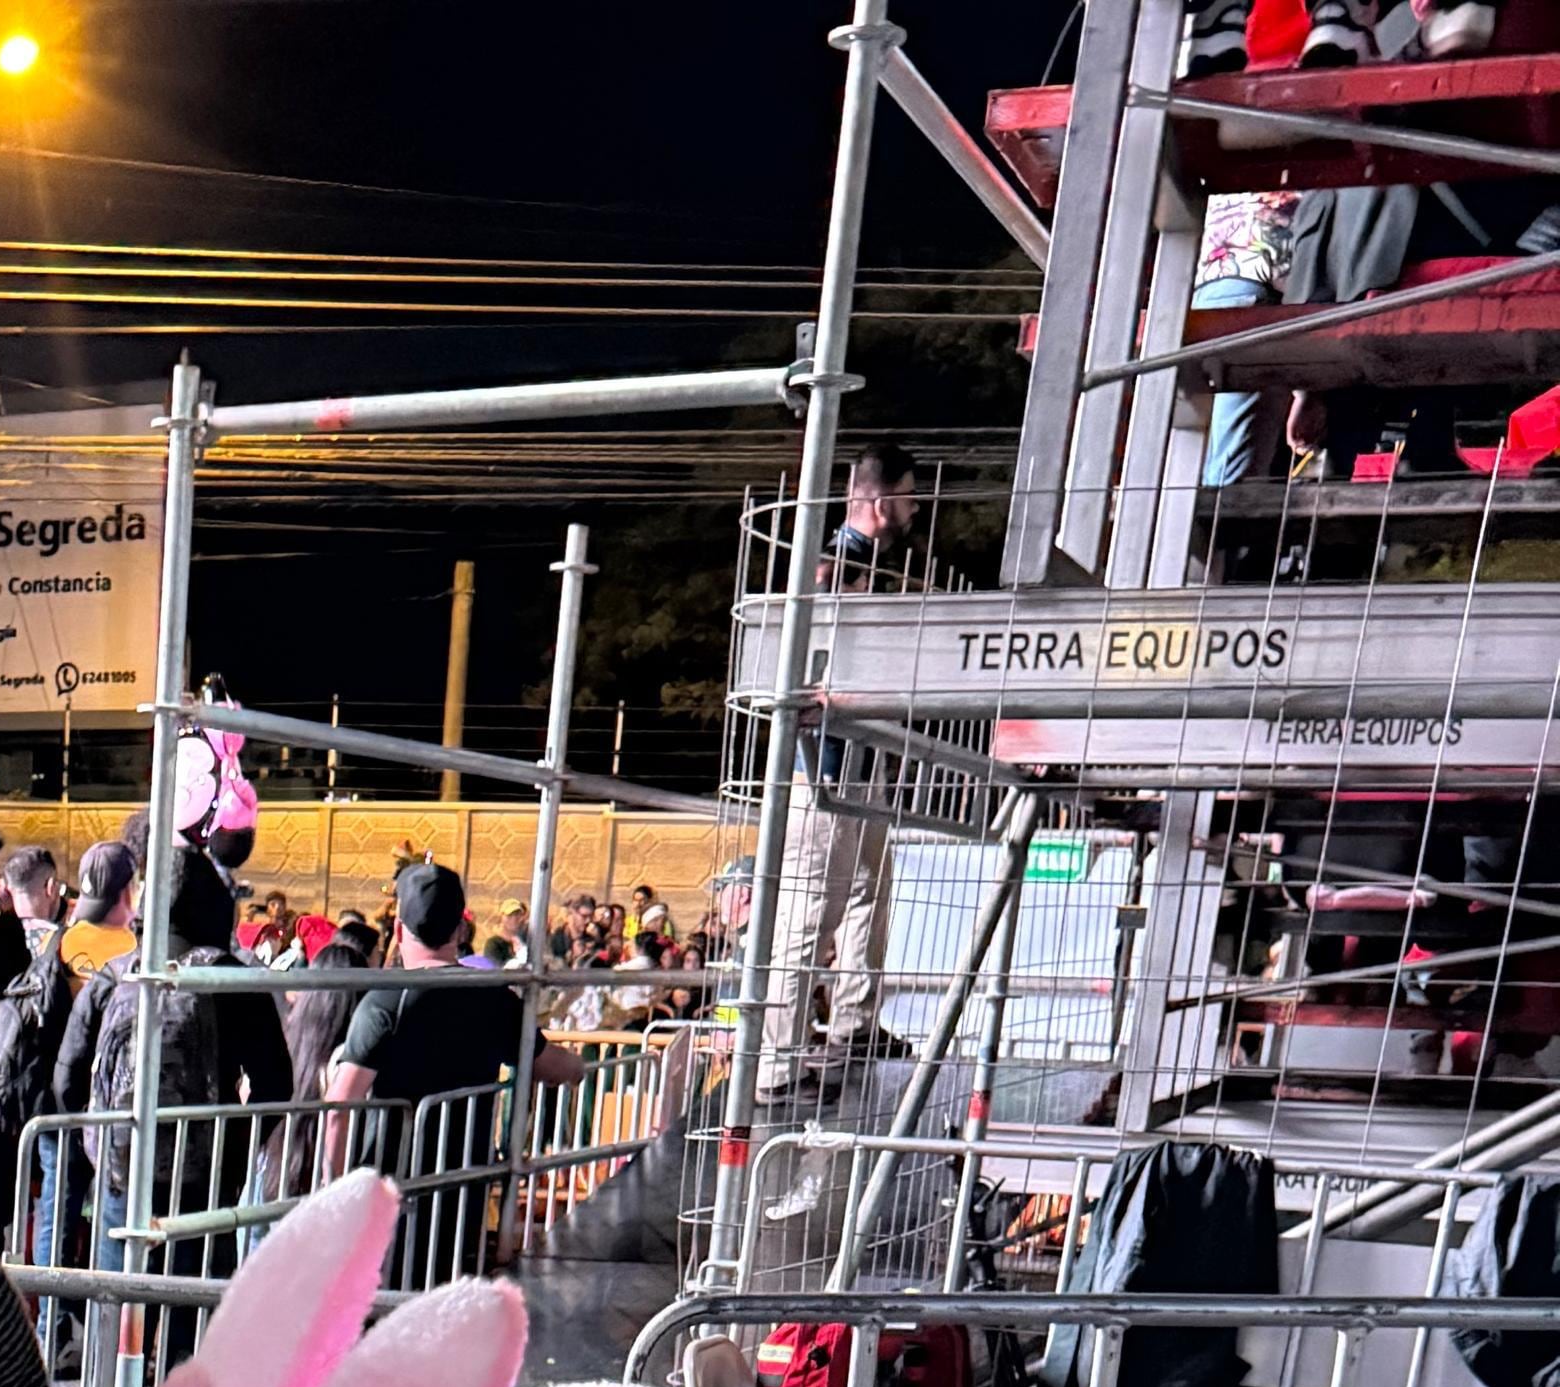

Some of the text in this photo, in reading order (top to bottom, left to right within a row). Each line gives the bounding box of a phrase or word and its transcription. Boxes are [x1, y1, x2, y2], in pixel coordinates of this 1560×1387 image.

[8, 571, 112, 596] Constancia
[958, 628, 1287, 671] TERRA EQUIPOS
[1264, 718, 1463, 746] TERRA EQUIPOS
